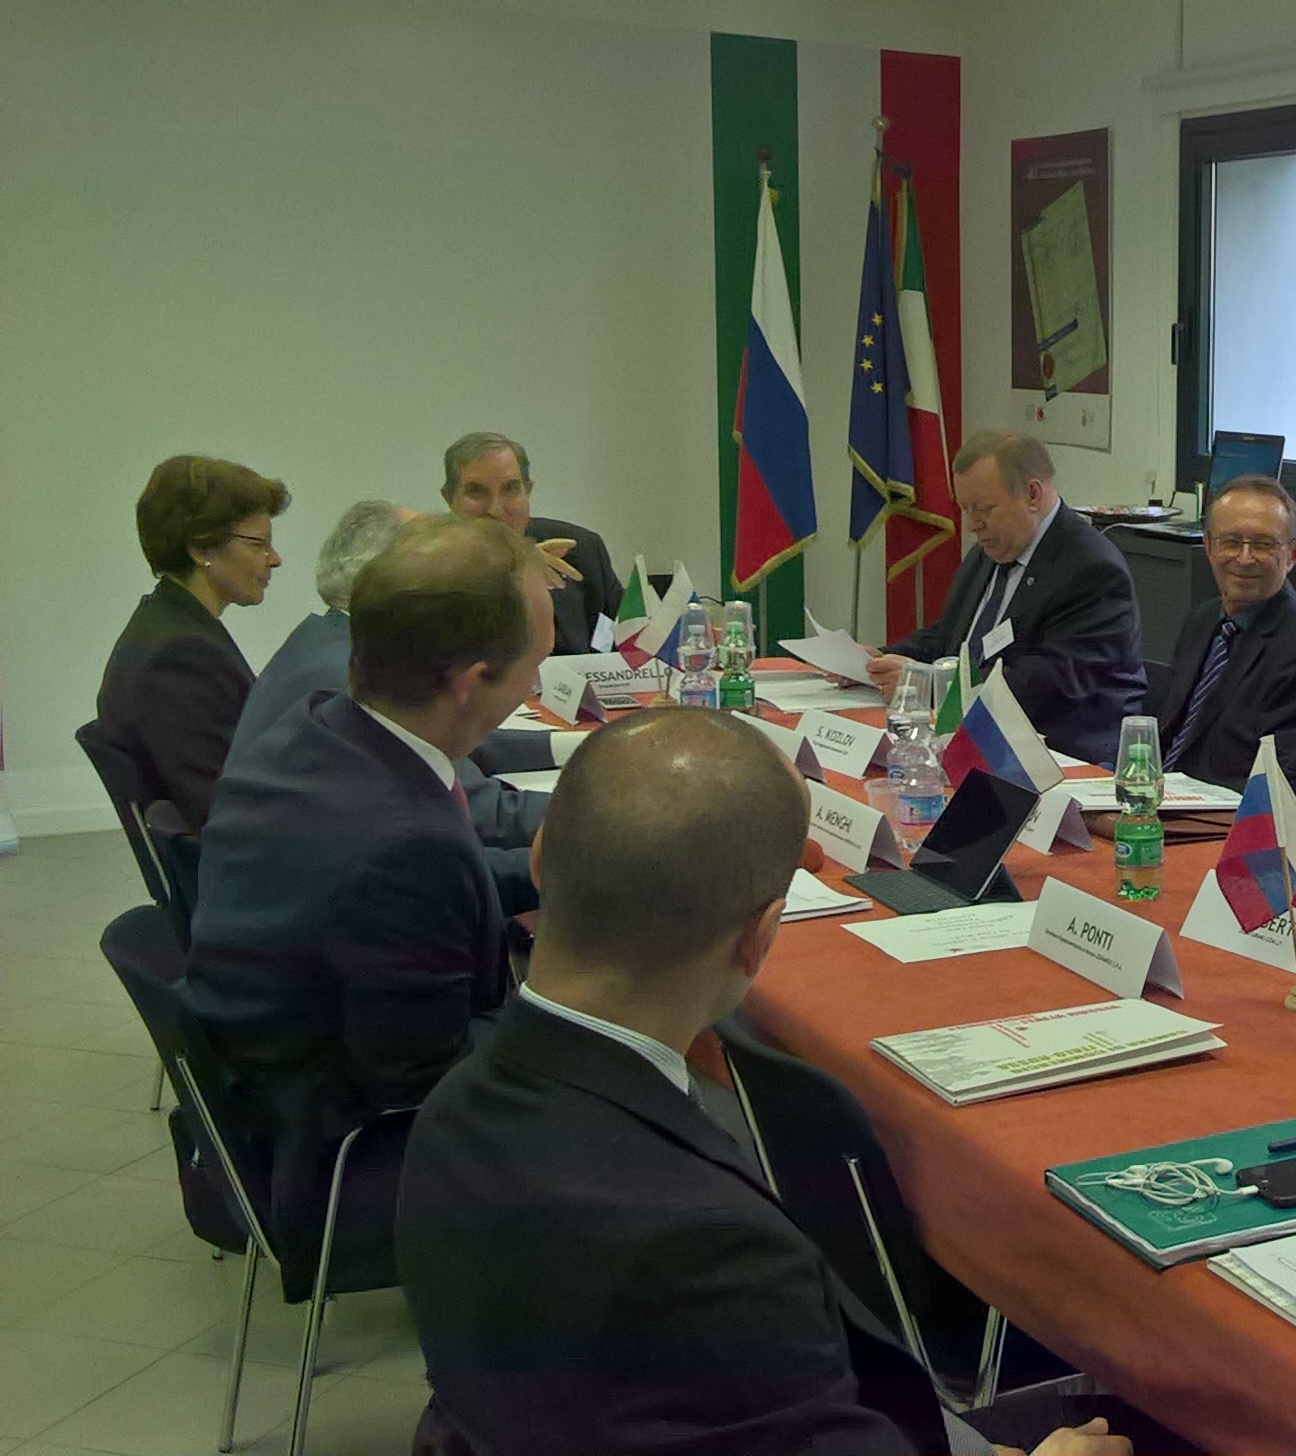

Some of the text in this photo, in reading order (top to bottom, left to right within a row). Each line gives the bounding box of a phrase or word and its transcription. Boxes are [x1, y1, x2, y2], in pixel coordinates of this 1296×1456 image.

[585, 667, 673, 682] ESSANDRELLO
[824, 728, 857, 747] KOZLOV
[1066, 916, 1077, 935] A.
[1080, 922, 1114, 951] PONTI
